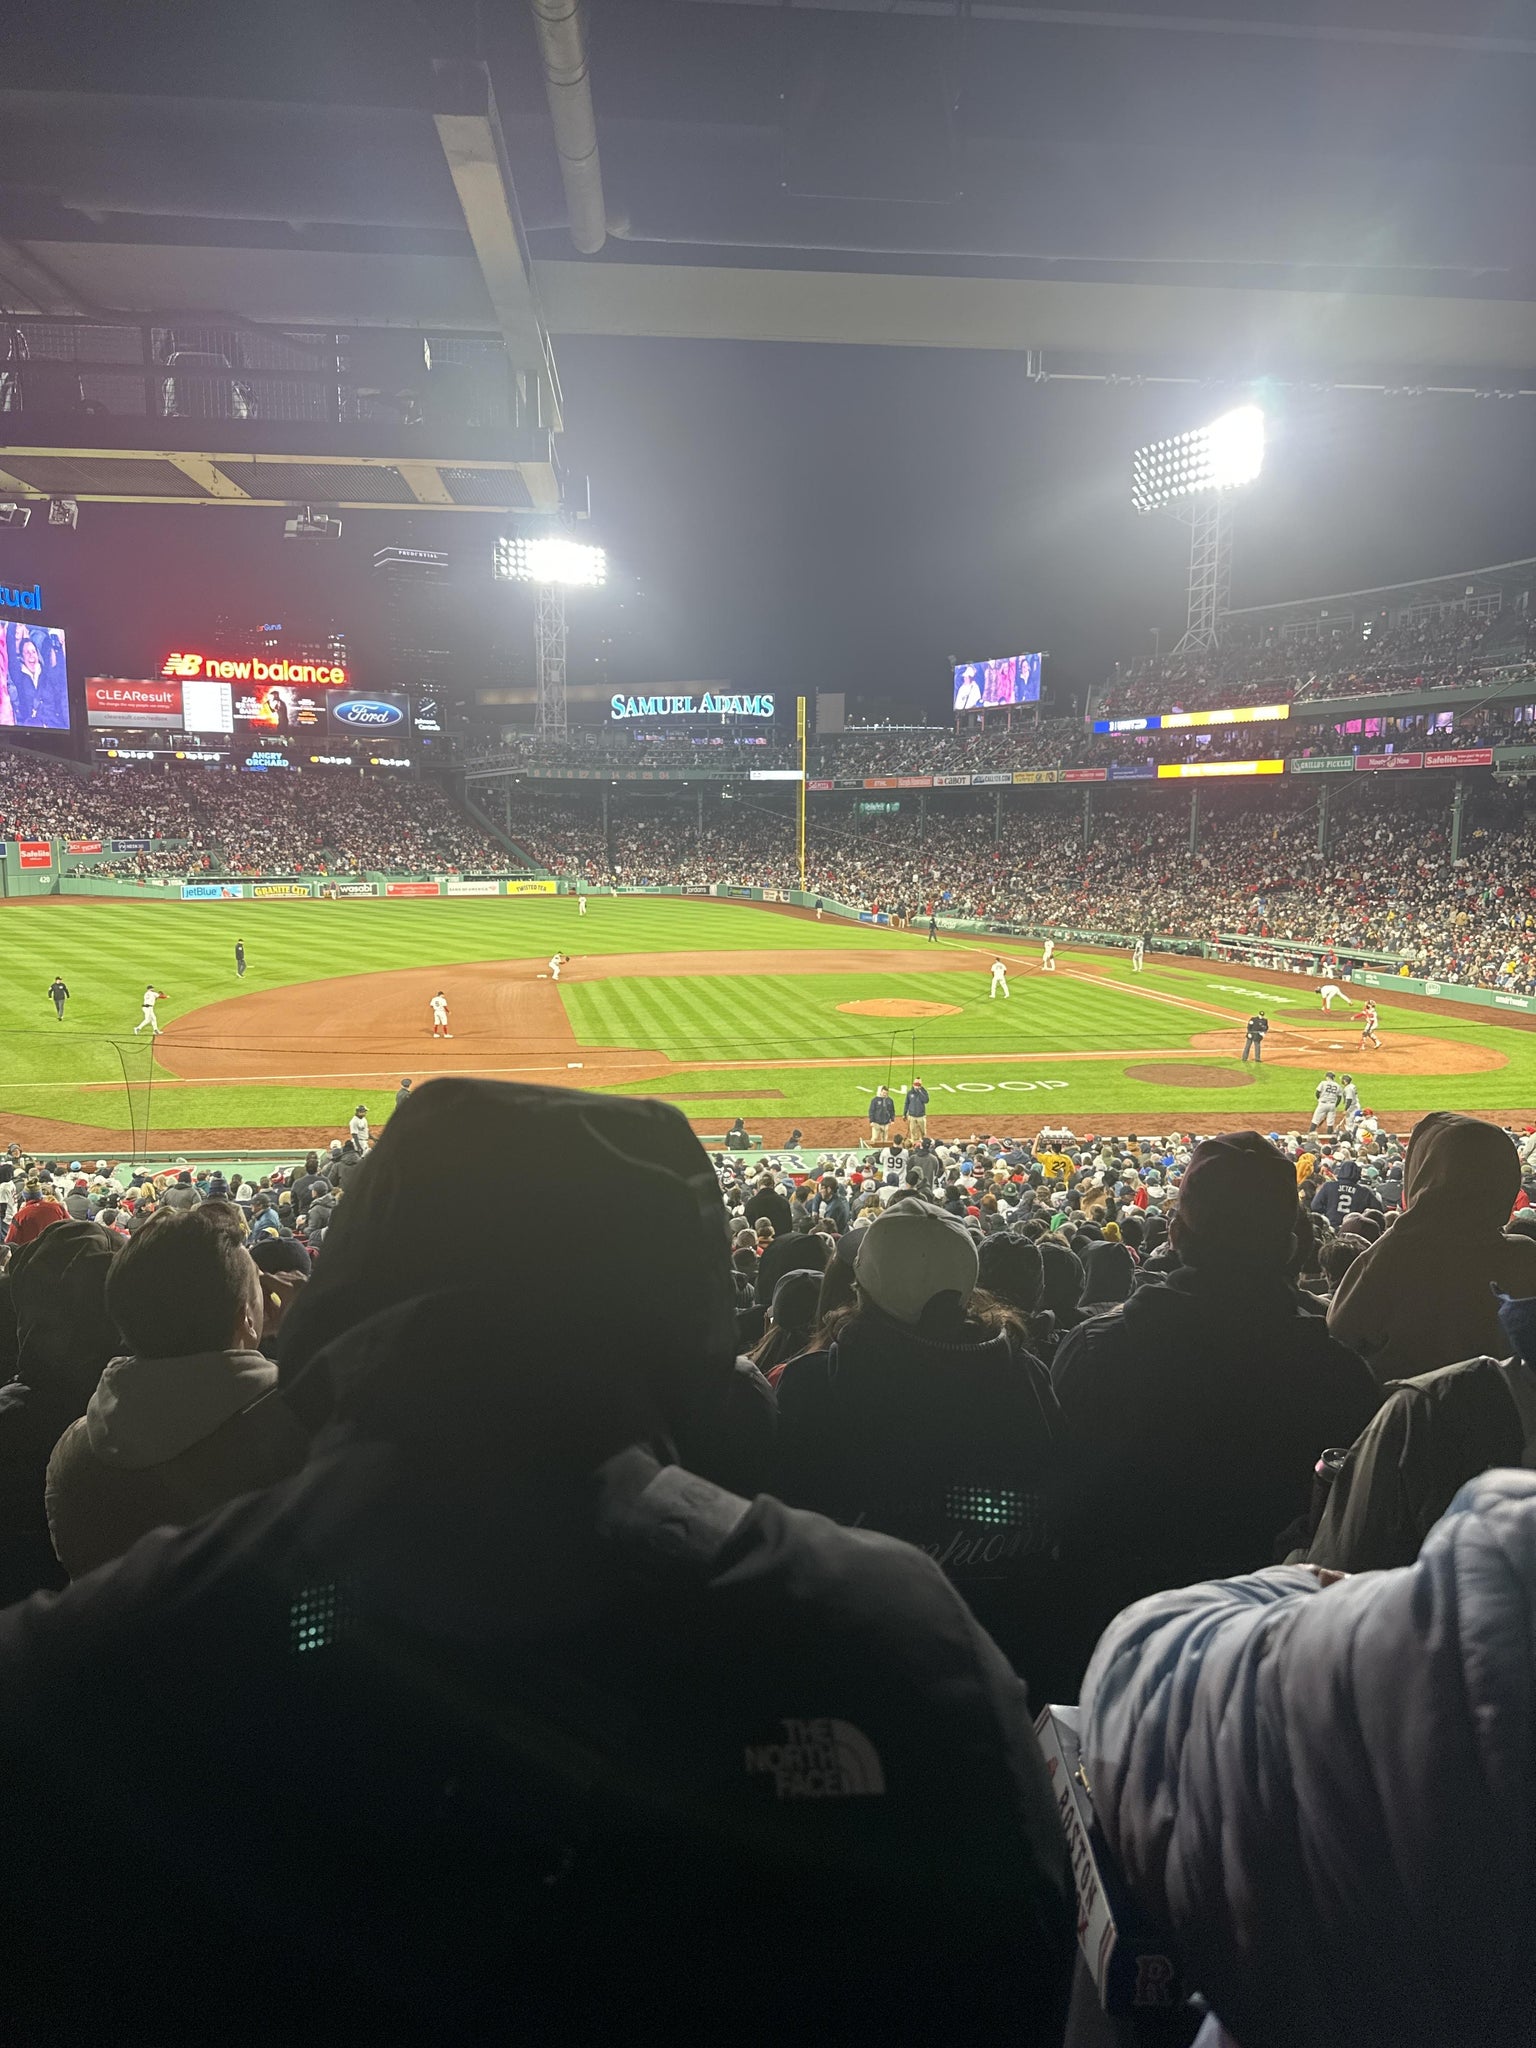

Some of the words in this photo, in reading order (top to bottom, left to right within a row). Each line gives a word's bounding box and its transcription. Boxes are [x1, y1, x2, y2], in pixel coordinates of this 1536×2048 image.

[611, 694, 696, 719] SAMUEL
[698, 692, 774, 717] ADAMS
[347, 704, 389, 723] Ford
[251, 752, 282, 760] ANGRY
[245, 758, 289, 767] ORCHARD
[185, 887, 217, 897] jetBlue
[255, 886, 292, 896] GRANITE
[293, 885, 310, 895] CITY
[340, 884, 372, 894] wasabi
[1326, 1084, 1338, 1094] 22
[887, 1157, 903, 1168] 99
[1337, 1194, 1352, 1213] 2
[781, 1717, 833, 1744] THE
[744, 1744, 840, 1772] NORTH
[774, 1770, 844, 1798] FACE
